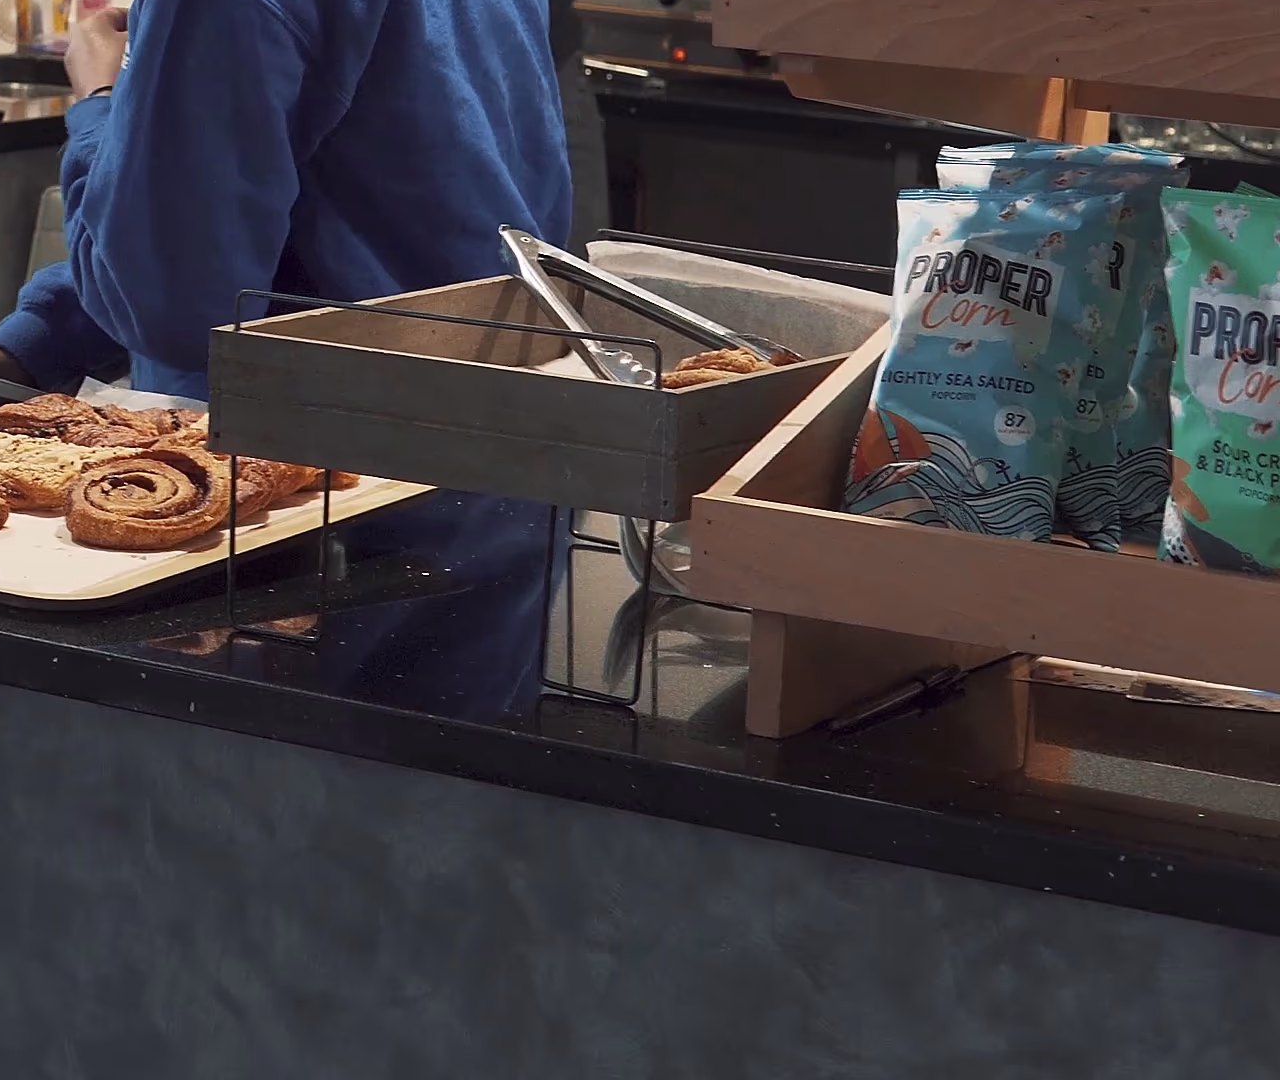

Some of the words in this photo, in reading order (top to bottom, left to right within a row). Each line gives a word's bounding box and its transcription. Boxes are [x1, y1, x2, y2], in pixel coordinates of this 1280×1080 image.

[905, 248, 1053, 318] PROPER
[922, 278, 1016, 330] Corn
[880, 369, 942, 387] LIGHTLY
[945, 373, 974, 387] SEA
[979, 374, 1035, 395] SALTED
[1004, 412, 1026, 427] 87
[1076, 398, 1097, 415] 87
[1212, 439, 1251, 464] SOUR
[1196, 455, 1208, 472] &
[1213, 458, 1265, 486] BLACK
